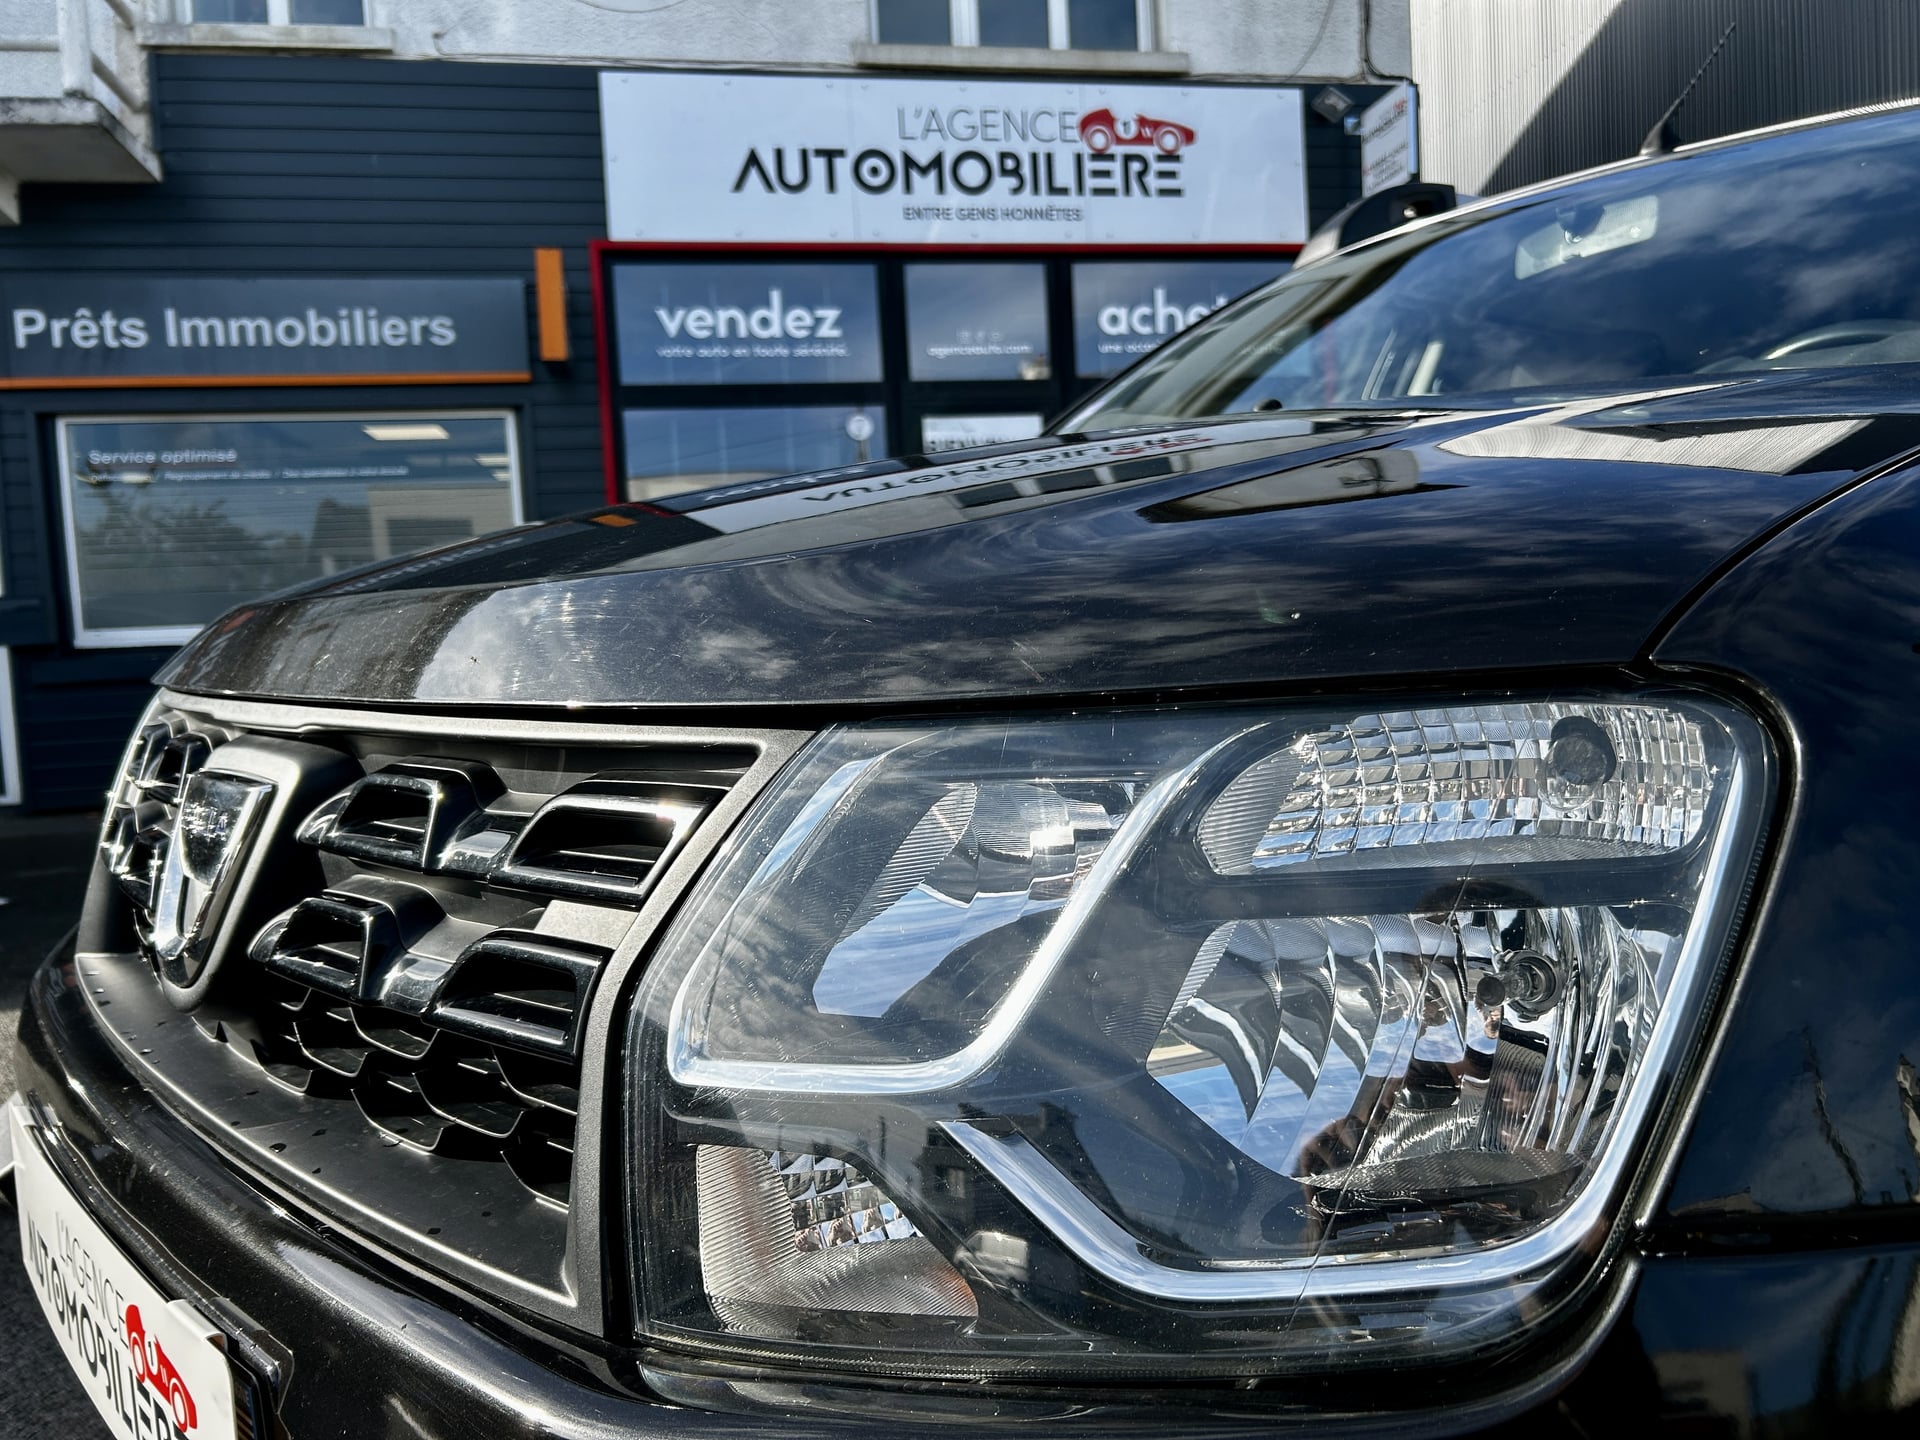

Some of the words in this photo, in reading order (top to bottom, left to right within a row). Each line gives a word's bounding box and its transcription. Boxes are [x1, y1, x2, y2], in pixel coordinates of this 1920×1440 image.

[897, 106, 1080, 143] L'AGENCE
[731, 147, 1184, 197] AUTOMOBILIERE
[903, 206, 952, 221] ENTRE
[955, 206, 997, 221] GENS
[1000, 204, 1083, 222] HONNÊTES
[12, 308, 149, 349] Prêts
[163, 308, 457, 347] Immobiliers
[655, 288, 843, 339] vendez
[88, 450, 157, 465] Service
[160, 448, 238, 466] optimisé
[56, 1211, 130, 1349] L'AGENCE
[27, 1211, 190, 1440] AUTOMOBILIER
